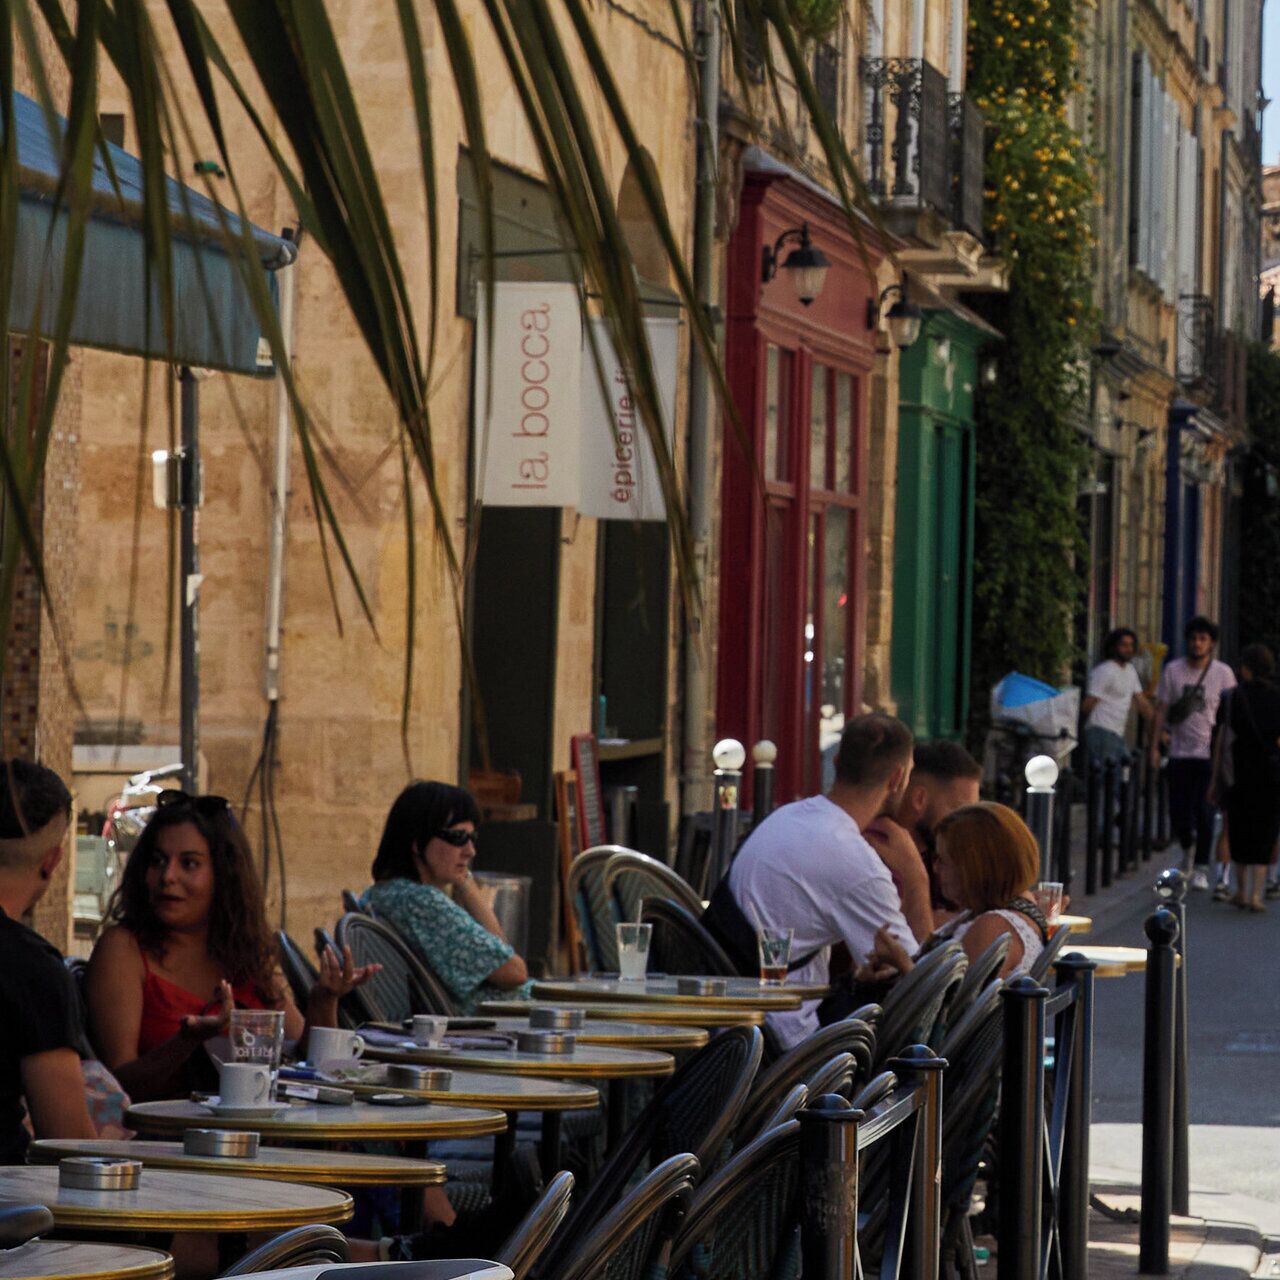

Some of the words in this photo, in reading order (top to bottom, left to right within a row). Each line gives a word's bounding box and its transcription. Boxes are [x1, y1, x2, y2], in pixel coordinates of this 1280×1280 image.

[512, 302, 550, 438] bocca
[511, 451, 550, 490] la
[610, 394, 636, 503] épicerie
